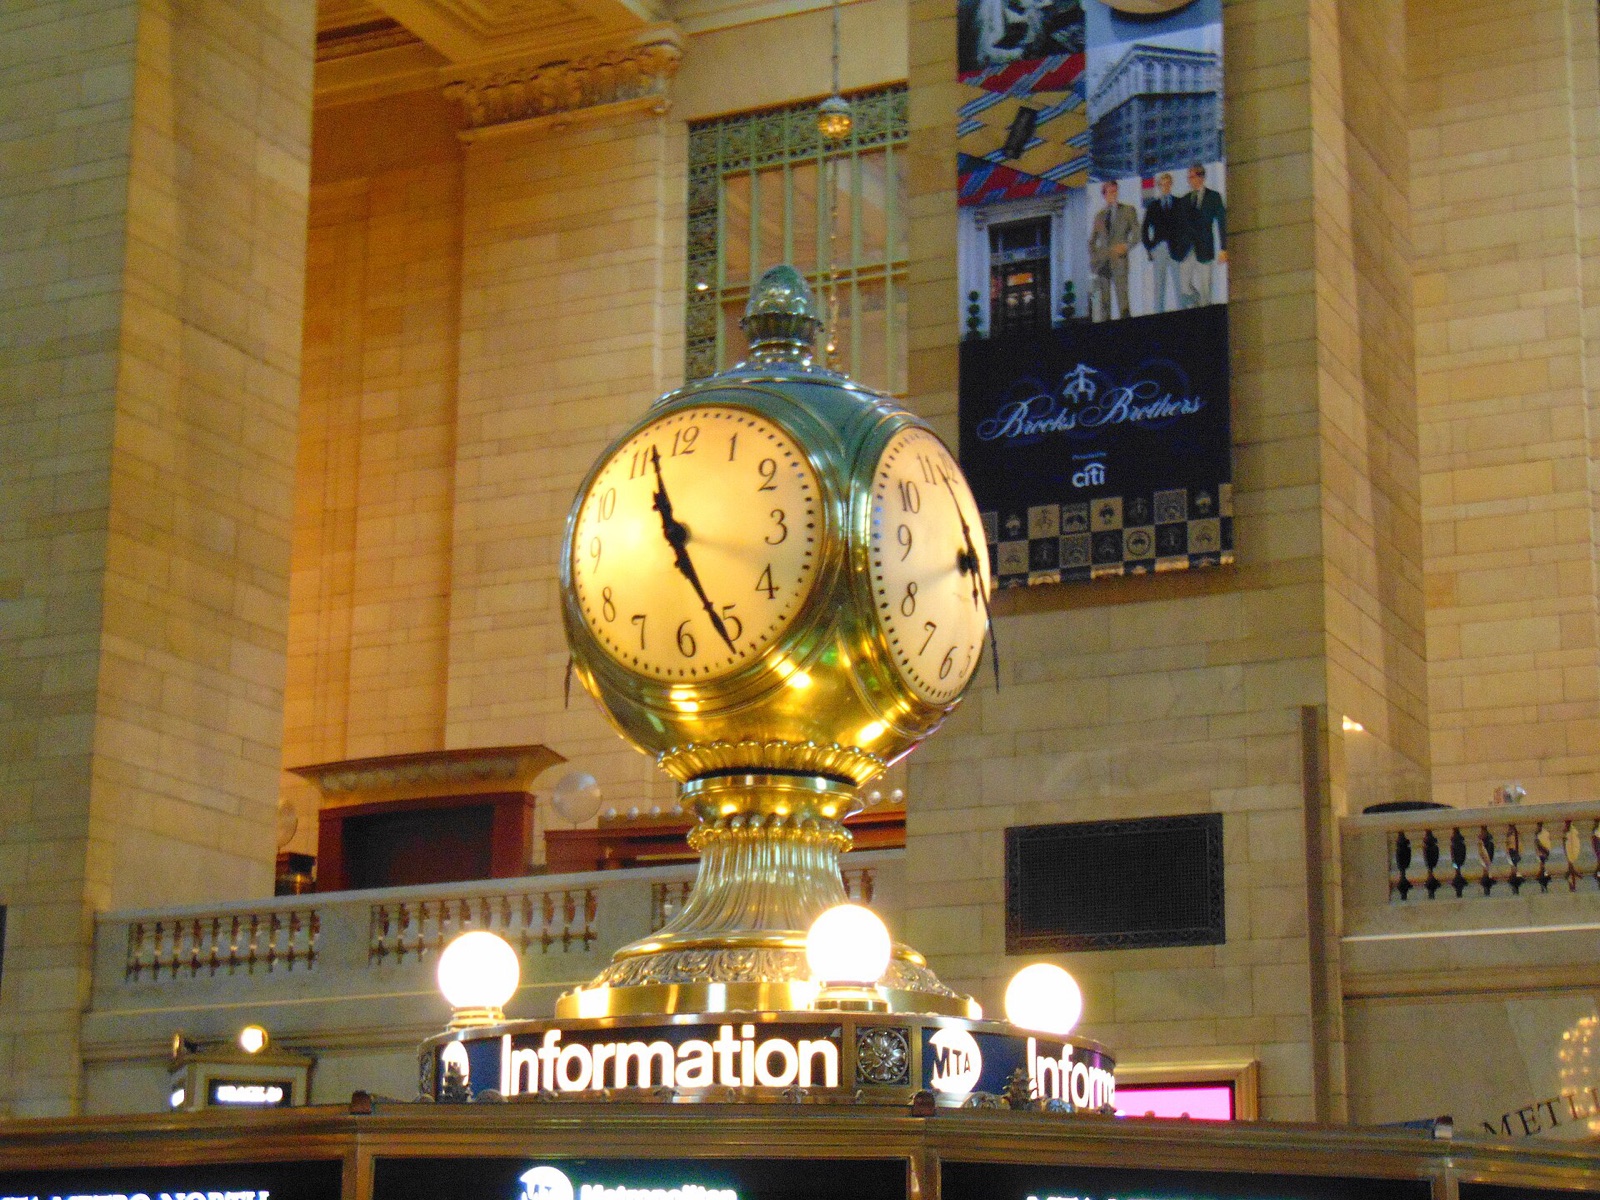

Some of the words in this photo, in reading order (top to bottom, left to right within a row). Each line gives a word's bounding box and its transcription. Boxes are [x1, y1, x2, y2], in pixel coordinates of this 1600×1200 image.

[977, 394, 1076, 440] Brooks
[1079, 381, 1200, 427] Brothers
[671, 426, 699, 457] 12
[728, 432, 738, 461] 1
[629, 447, 649, 480] 11
[757, 458, 778, 492] 2
[917, 453, 936, 485] 11
[1072, 463, 1105, 487] citi
[597, 487, 616, 523] 10
[898, 479, 920, 514] 10
[764, 509, 788, 546] 3
[898, 524, 912, 562] 9
[590, 537, 602, 575] 9
[755, 563, 780, 600] 4
[901, 581, 918, 618] 8
[602, 586, 616, 623] 8
[722, 604, 743, 642] 5
[631, 614, 647, 651] 7
[676, 619, 697, 658] 6
[918, 621, 937, 656] 7
[939, 646, 958, 680] 6
[502, 1024, 839, 1096] Information
[928, 1042, 971, 1080] MTA
